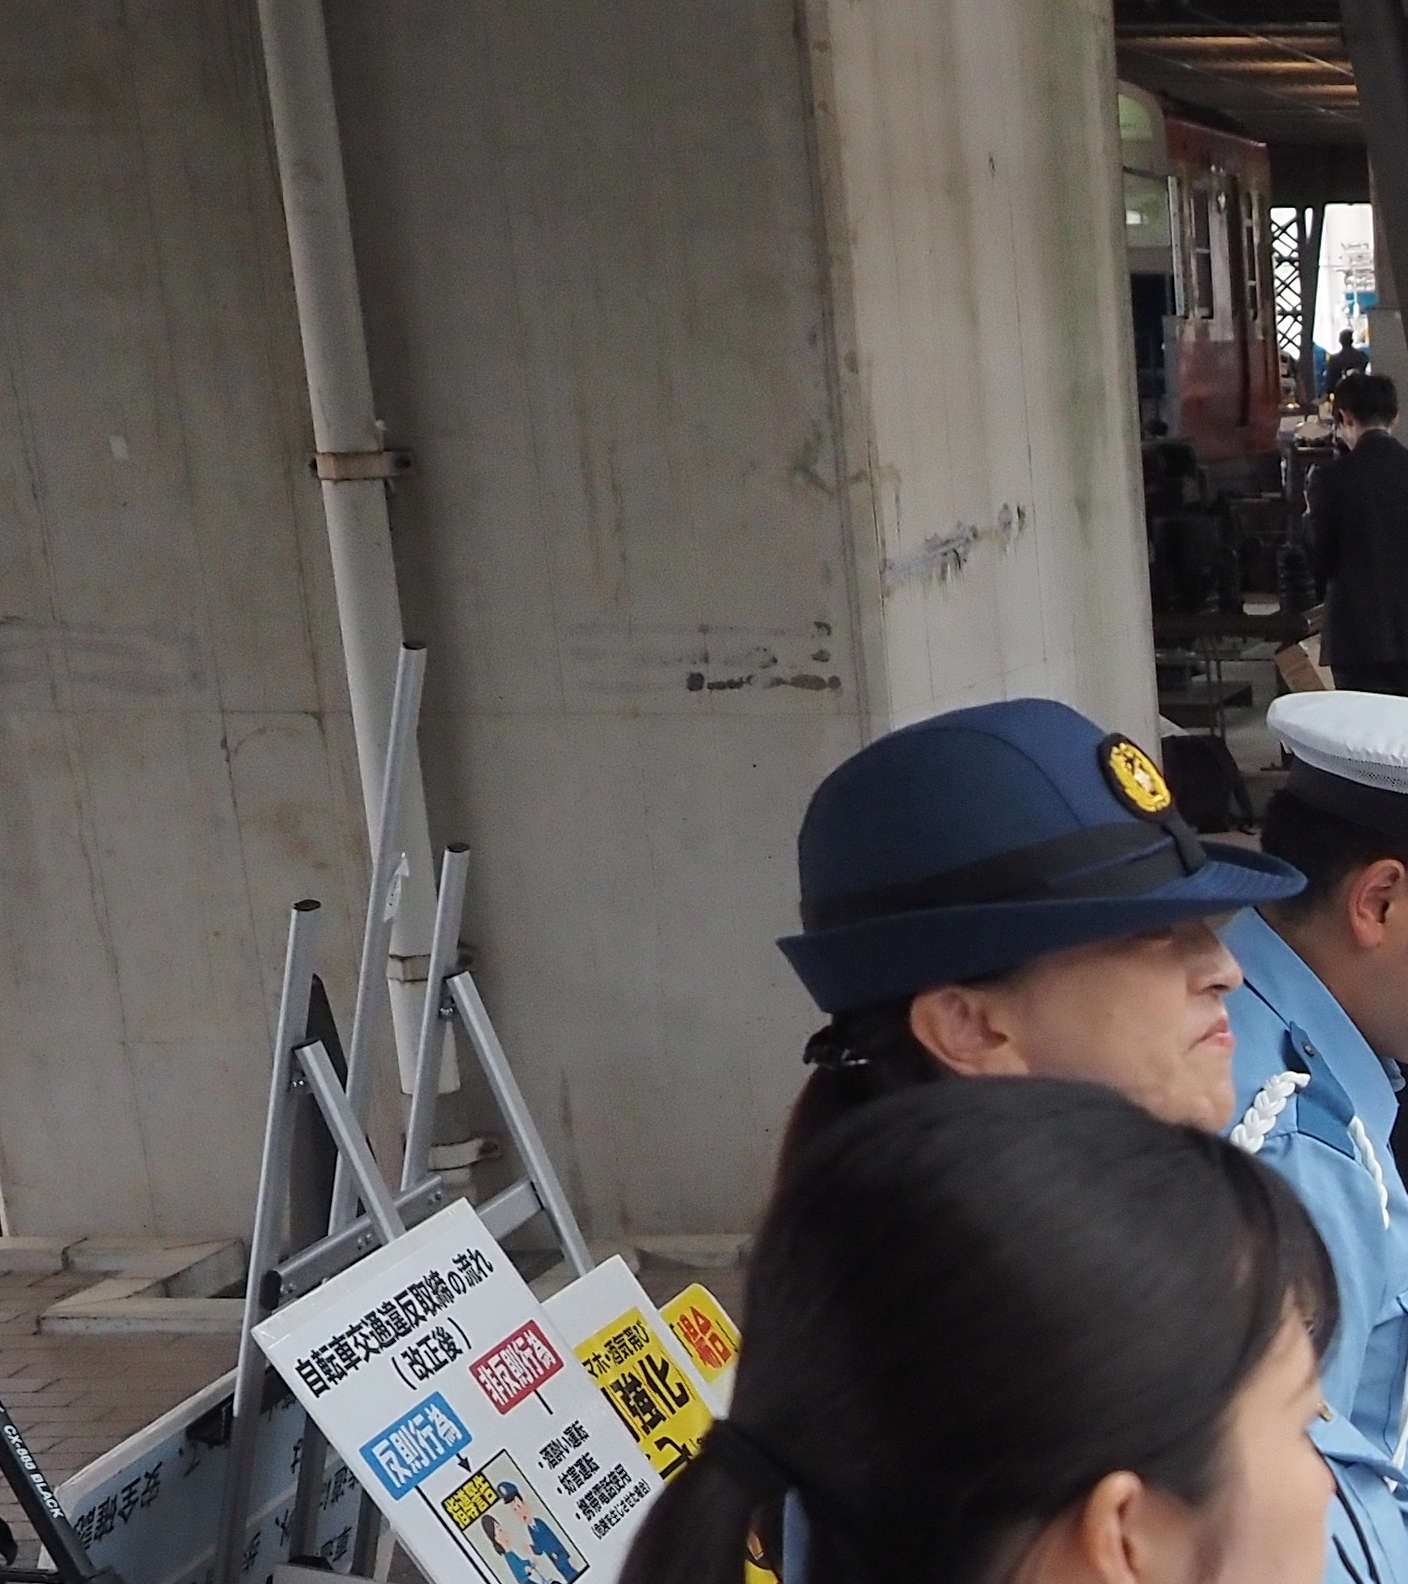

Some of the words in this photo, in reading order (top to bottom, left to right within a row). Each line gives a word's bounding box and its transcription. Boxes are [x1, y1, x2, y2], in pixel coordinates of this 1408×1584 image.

[295, 1247, 495, 1399] 自転車交通違反取締の流れ
[475, 1327, 557, 1408] 非反則行為
[601, 1354, 691, 1443] 強化
[371, 1409, 464, 1488] 反則行為
[30, 1471, 65, 1520] BLACK
